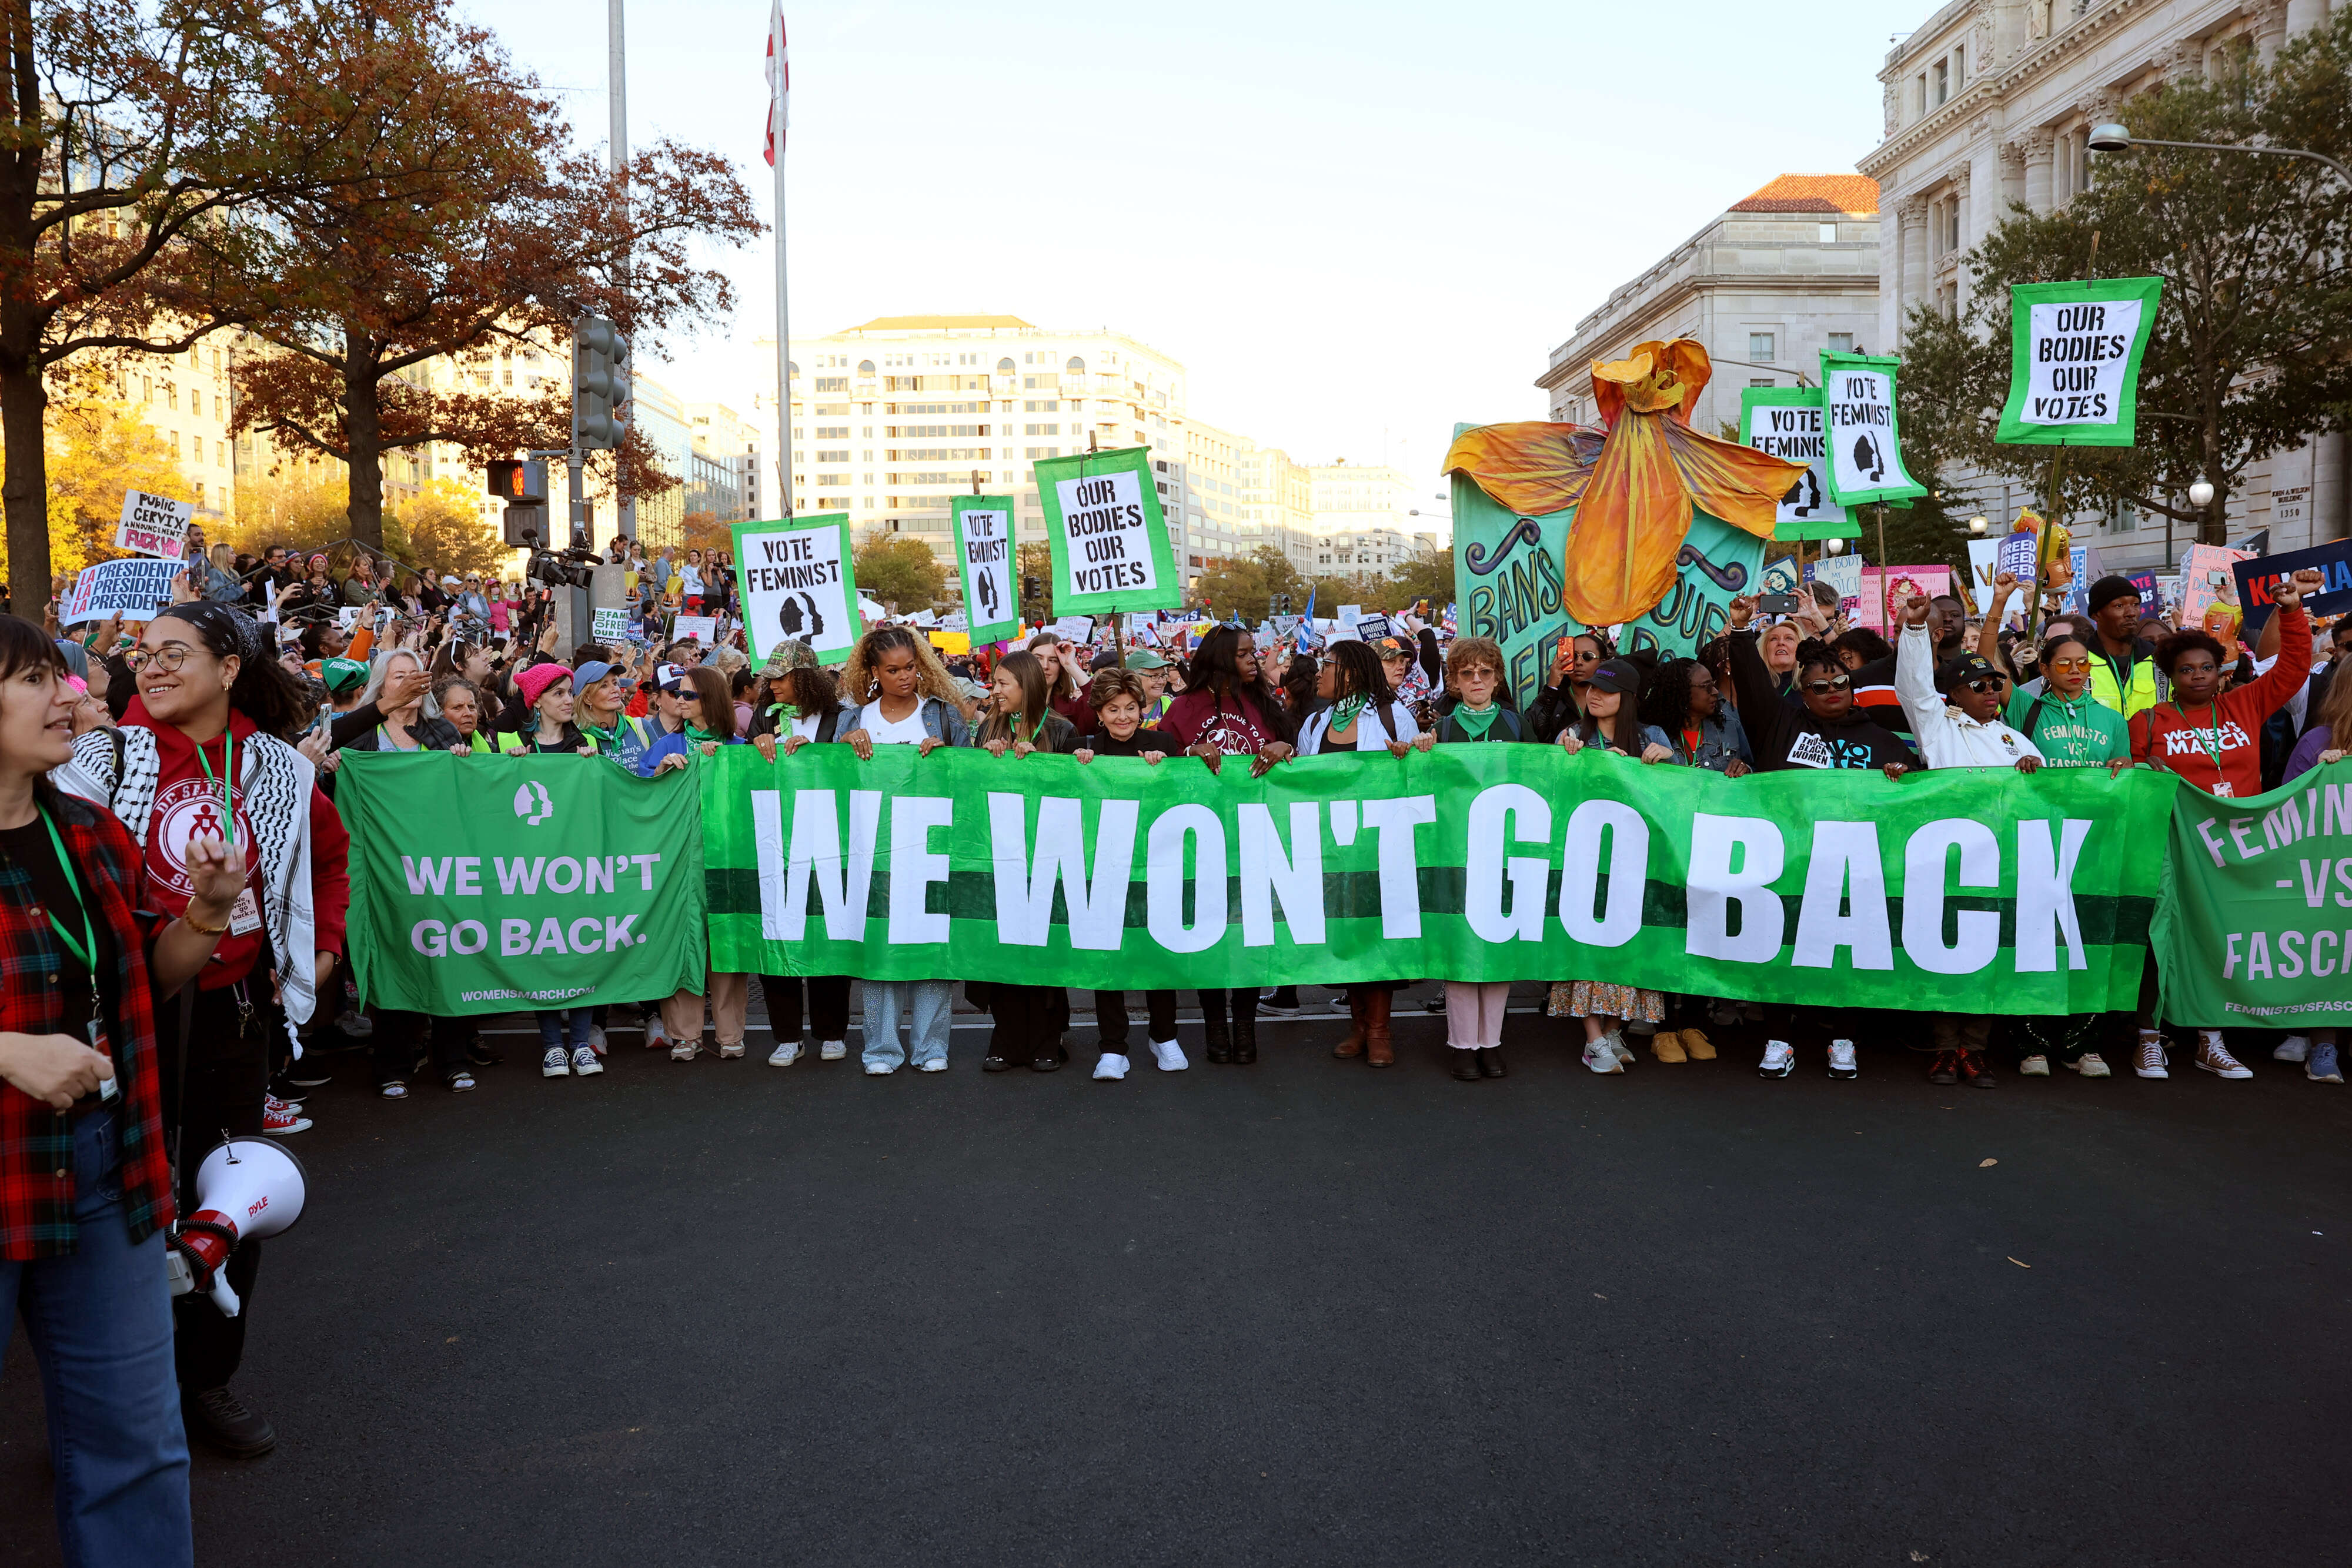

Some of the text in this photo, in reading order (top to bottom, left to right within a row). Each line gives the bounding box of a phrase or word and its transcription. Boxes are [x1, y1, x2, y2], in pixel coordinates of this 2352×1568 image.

[2057, 306, 2106, 332] OUR
[2039, 335, 2125, 363] BODIES
[1846, 376, 1877, 401] VOTE
[2053, 366, 2097, 392] OUR
[1831, 403, 1892, 429] FEMINIST
[2034, 392, 2107, 420] VOTES
[1771, 409, 1822, 433] VOTE
[1752, 436, 1826, 459] FEMINIS
[1077, 480, 1115, 507] OUR
[2272, 489, 2284, 497] JOHN
[2291, 486, 2310, 495] WILSON
[2278, 494, 2303, 503] BUILDING
[133, 507, 185, 530] CERVIX
[1068, 504, 1142, 537] BODIES
[2280, 508, 2300, 518] 1350
[124, 521, 182, 537] ANNOUNCEMENT
[968, 514, 993, 537] VOTE
[125, 529, 159, 551] FUCK
[763, 537, 813, 563] VOTE
[965, 537, 1007, 564] EMINIST
[1085, 535, 1124, 563] OUR
[2001, 539, 2036, 559] FREED
[1816, 554, 1861, 573] MY BODY
[2000, 551, 2036, 571] FREED
[2197, 547, 2227, 561] VOTE
[81, 569, 96, 586] LA
[747, 559, 838, 593] FEMINIST
[1075, 560, 1146, 592] VOTES
[76, 577, 173, 600] LA PRESIDENT
[1469, 547, 1562, 645] BANS
[71, 599, 86, 616] LA
[595, 610, 606, 628] OUR
[1359, 622, 1387, 635] HARRIS
[1367, 631, 1387, 640] WALZ
[1250, 724, 1259, 738] TO
[2163, 721, 2241, 741] WOMEN'S
[1798, 743, 1826, 755] BLACK
[2167, 731, 2251, 756] MARCH
[1792, 751, 1829, 766] WOMEN
[155, 793, 178, 814] DC
[400, 853, 660, 895] WE WON’T
[750, 783, 2094, 975] WE WON'T GO BACK
[411, 914, 646, 957] GO BACK.
[461, 985, 596, 1002] WOMENSMARCH.COM
[248, 1195, 268, 1218] PYLE
